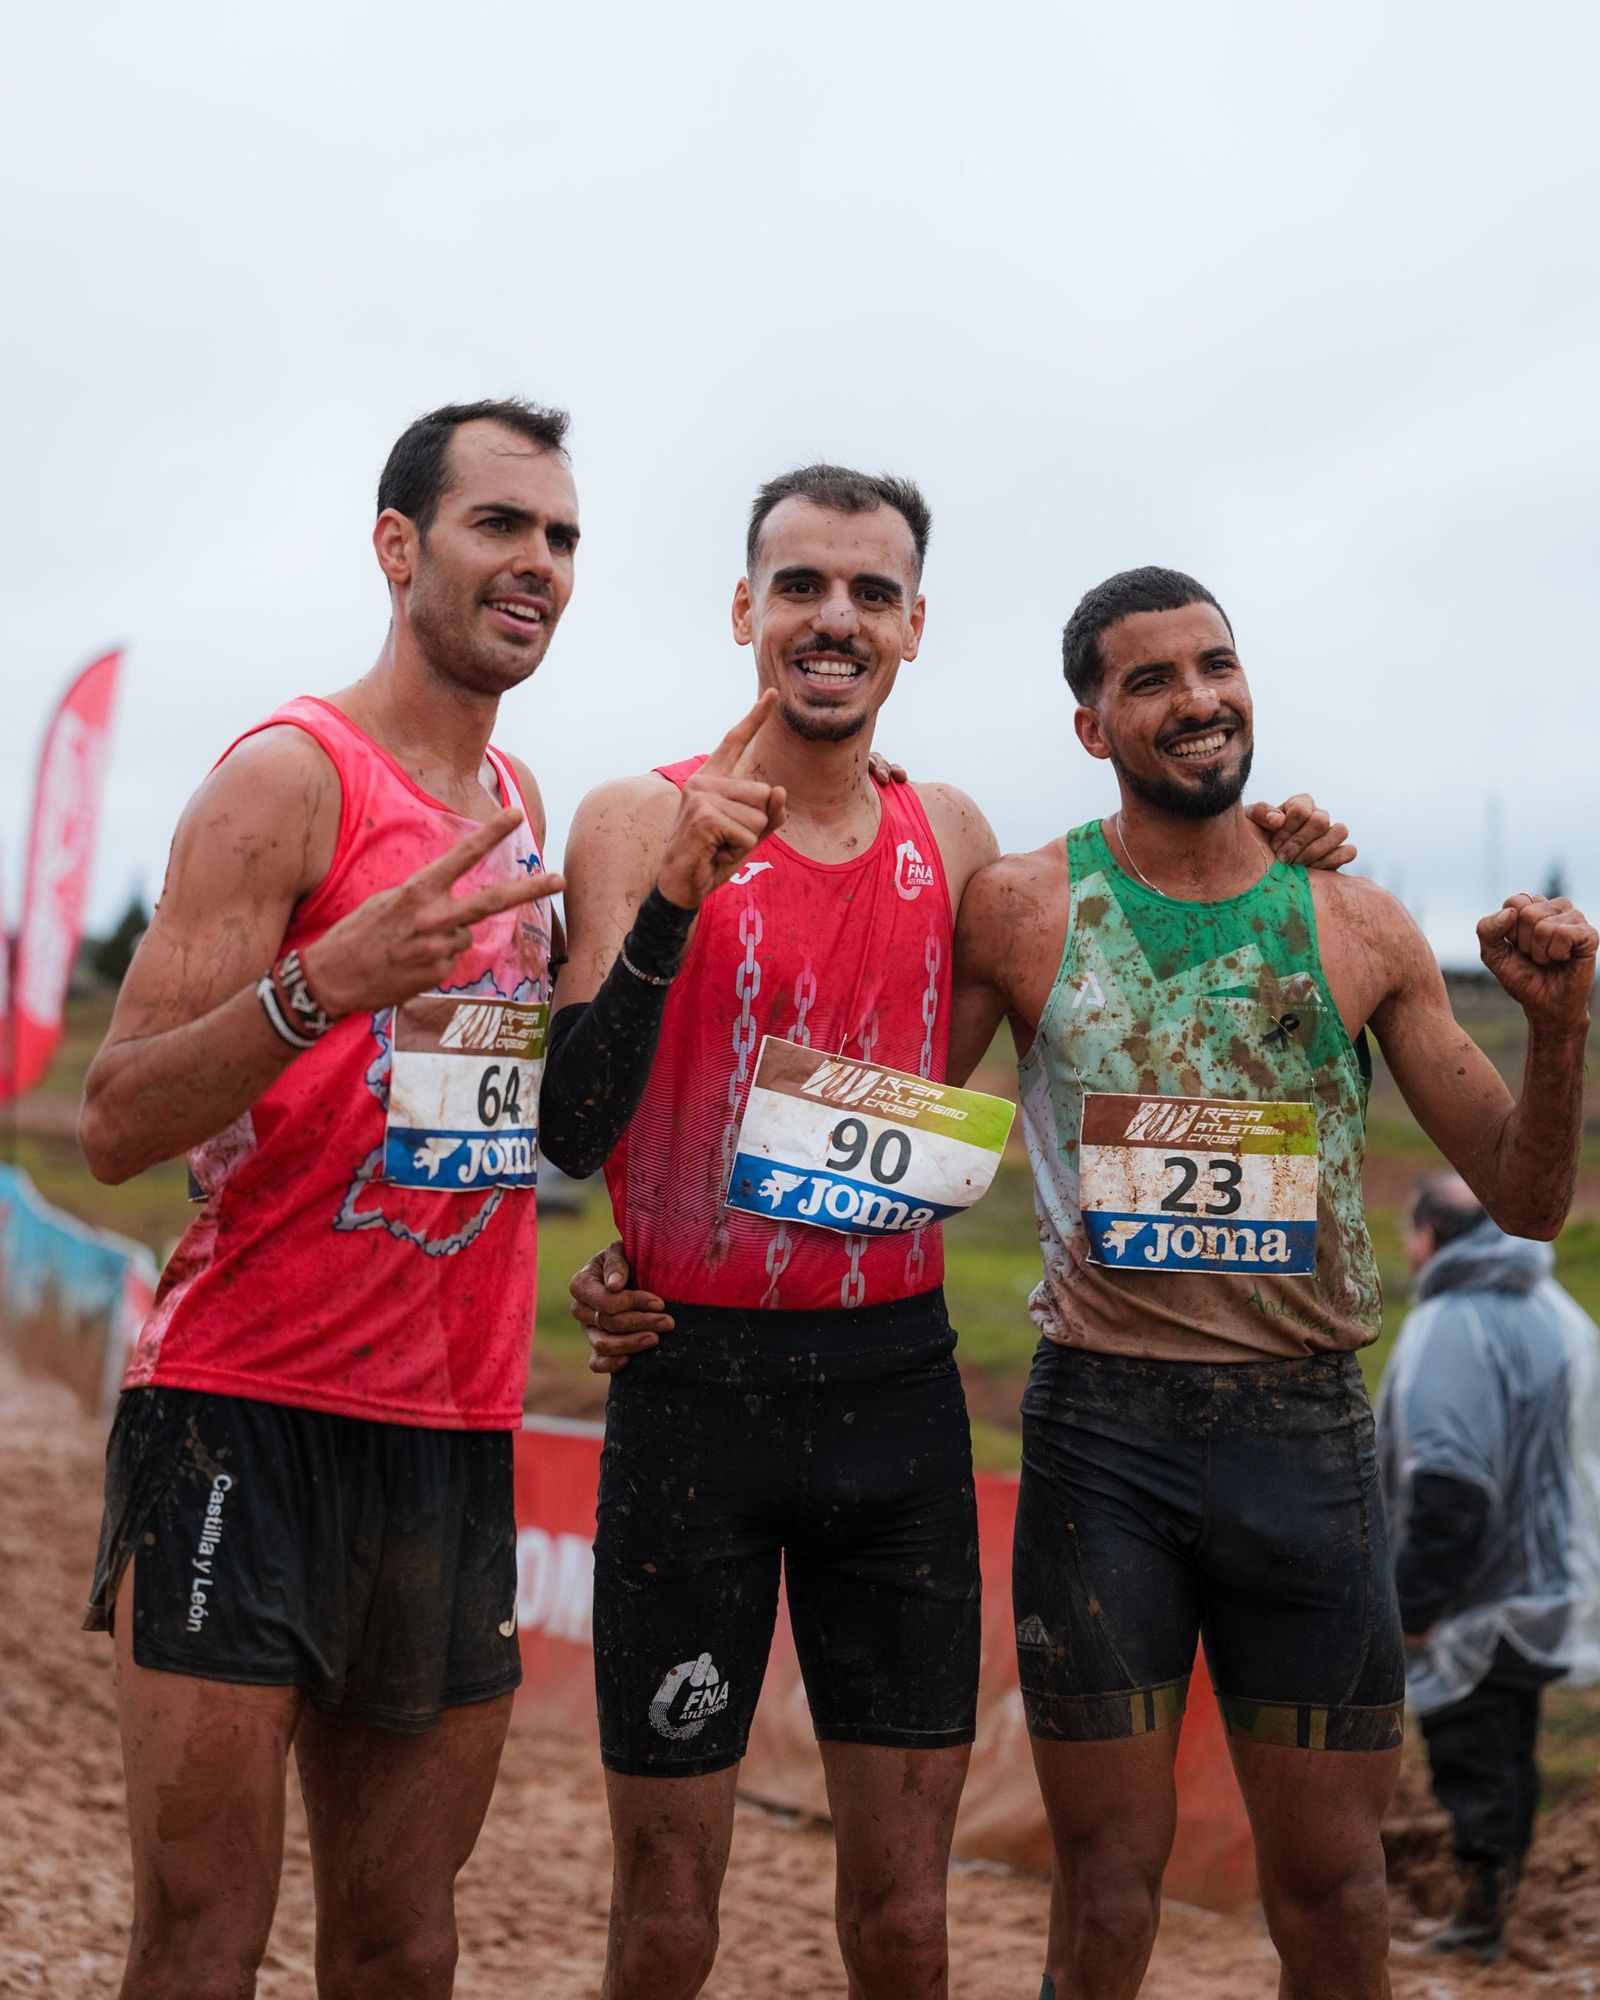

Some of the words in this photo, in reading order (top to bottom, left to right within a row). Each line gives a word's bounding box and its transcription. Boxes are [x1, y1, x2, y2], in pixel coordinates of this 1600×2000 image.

[907, 864, 933, 879] FNA
[478, 1065, 522, 1127] 64
[862, 1097, 919, 1119] CROSS
[872, 1088, 968, 1120] ATLETISMO
[825, 1118, 912, 1185] 90
[1187, 1133, 1244, 1146] CROSS
[458, 1137, 537, 1184] Jom
[1160, 1156, 1243, 1215] 23
[198, 1473, 232, 1556] Castilla
[192, 1557, 213, 1575] y
[186, 1579, 214, 1634] León
[679, 1700, 728, 1720] ATLETISMO
[683, 1681, 729, 1712] FNA
